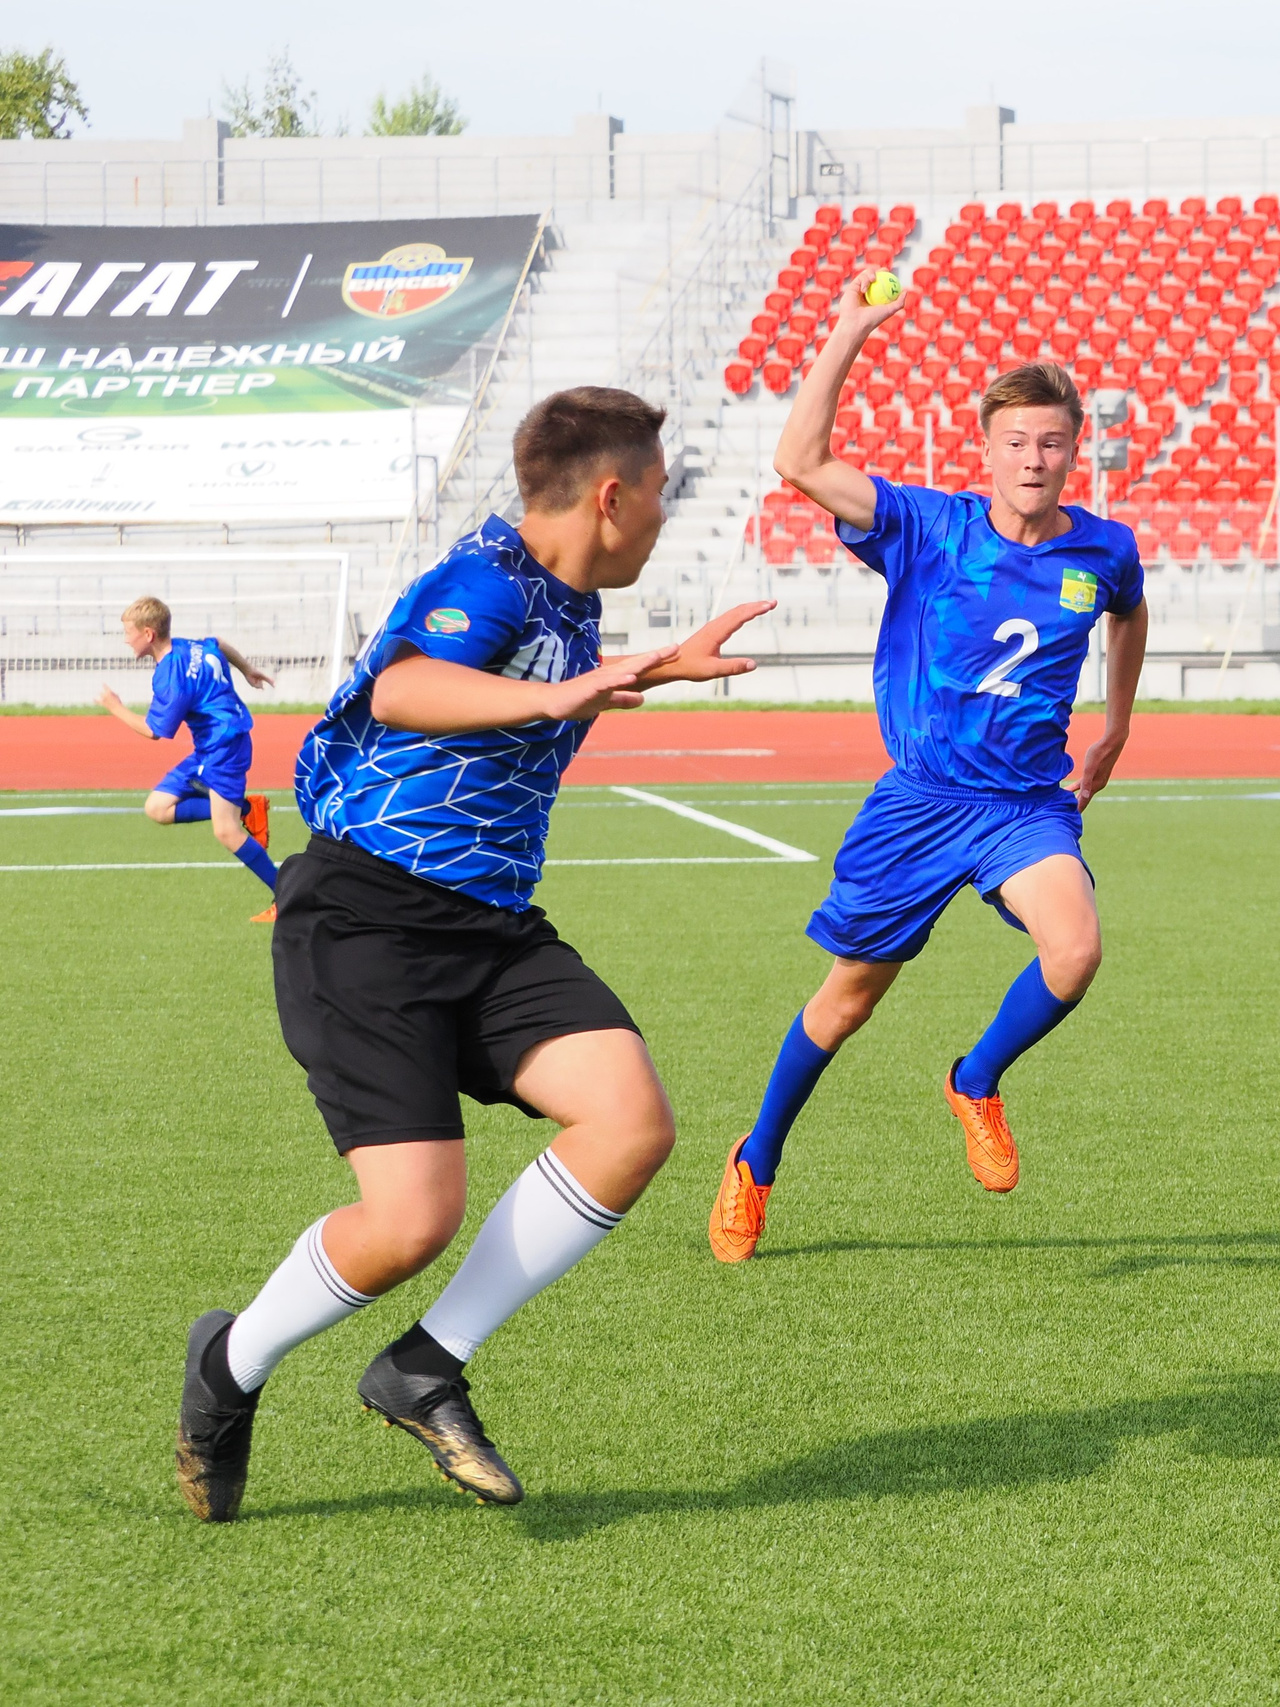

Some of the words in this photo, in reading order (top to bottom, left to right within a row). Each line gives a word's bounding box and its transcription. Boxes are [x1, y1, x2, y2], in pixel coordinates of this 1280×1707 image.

[0, 261, 258, 317] АГАТ
[58, 335, 406, 374] НАДЕЖНЫЙ
[12, 373, 276, 399] ПАРТНЕР
[81, 443, 190, 452] MOTOR
[220, 438, 362, 450] HAVAL
[976, 618, 1039, 698] 2
